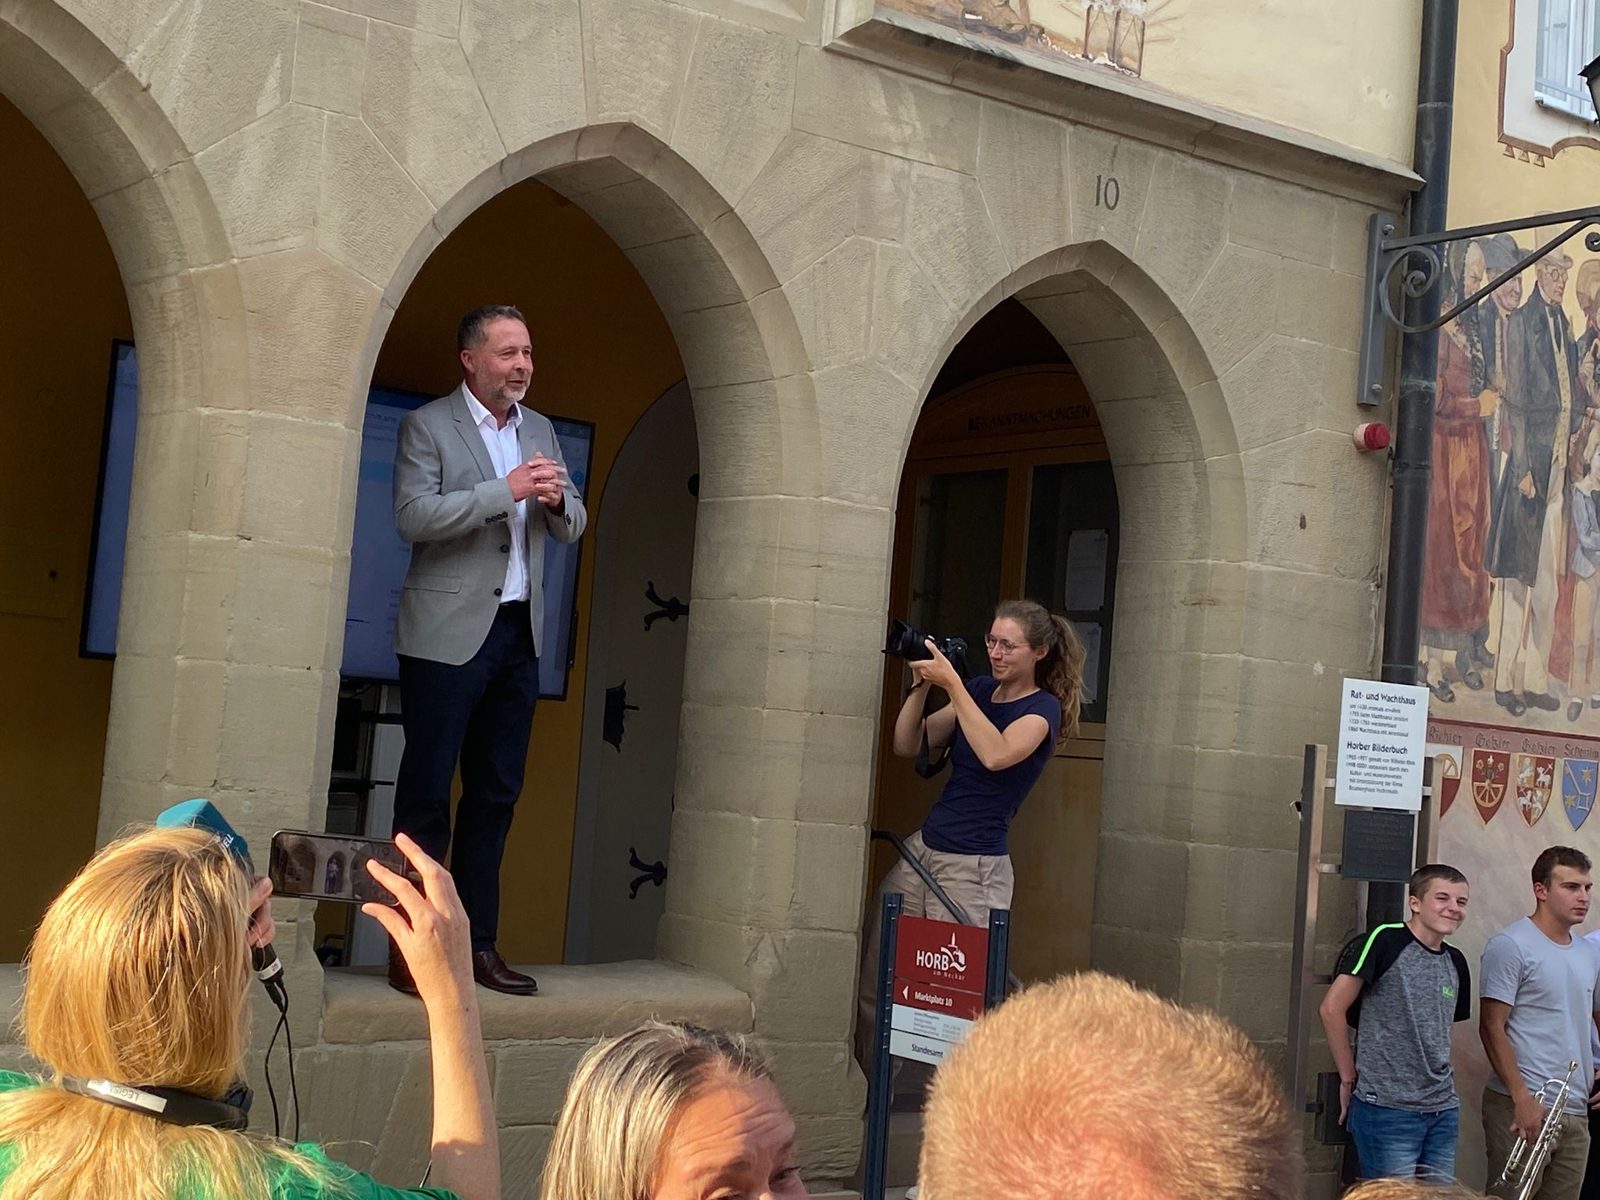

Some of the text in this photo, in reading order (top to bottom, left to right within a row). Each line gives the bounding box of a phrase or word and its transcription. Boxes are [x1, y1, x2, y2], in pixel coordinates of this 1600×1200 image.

[1095, 174, 1120, 211] 10
[1365, 692, 1380, 701] und
[1380, 692, 1416, 705] Wachthaus
[1346, 740, 1408, 755] Horber Bilderbuch
[916, 949, 950, 972] HORB
[914, 990, 953, 1007] Marktplatz 10
[911, 1043, 944, 1058] Standesamt
